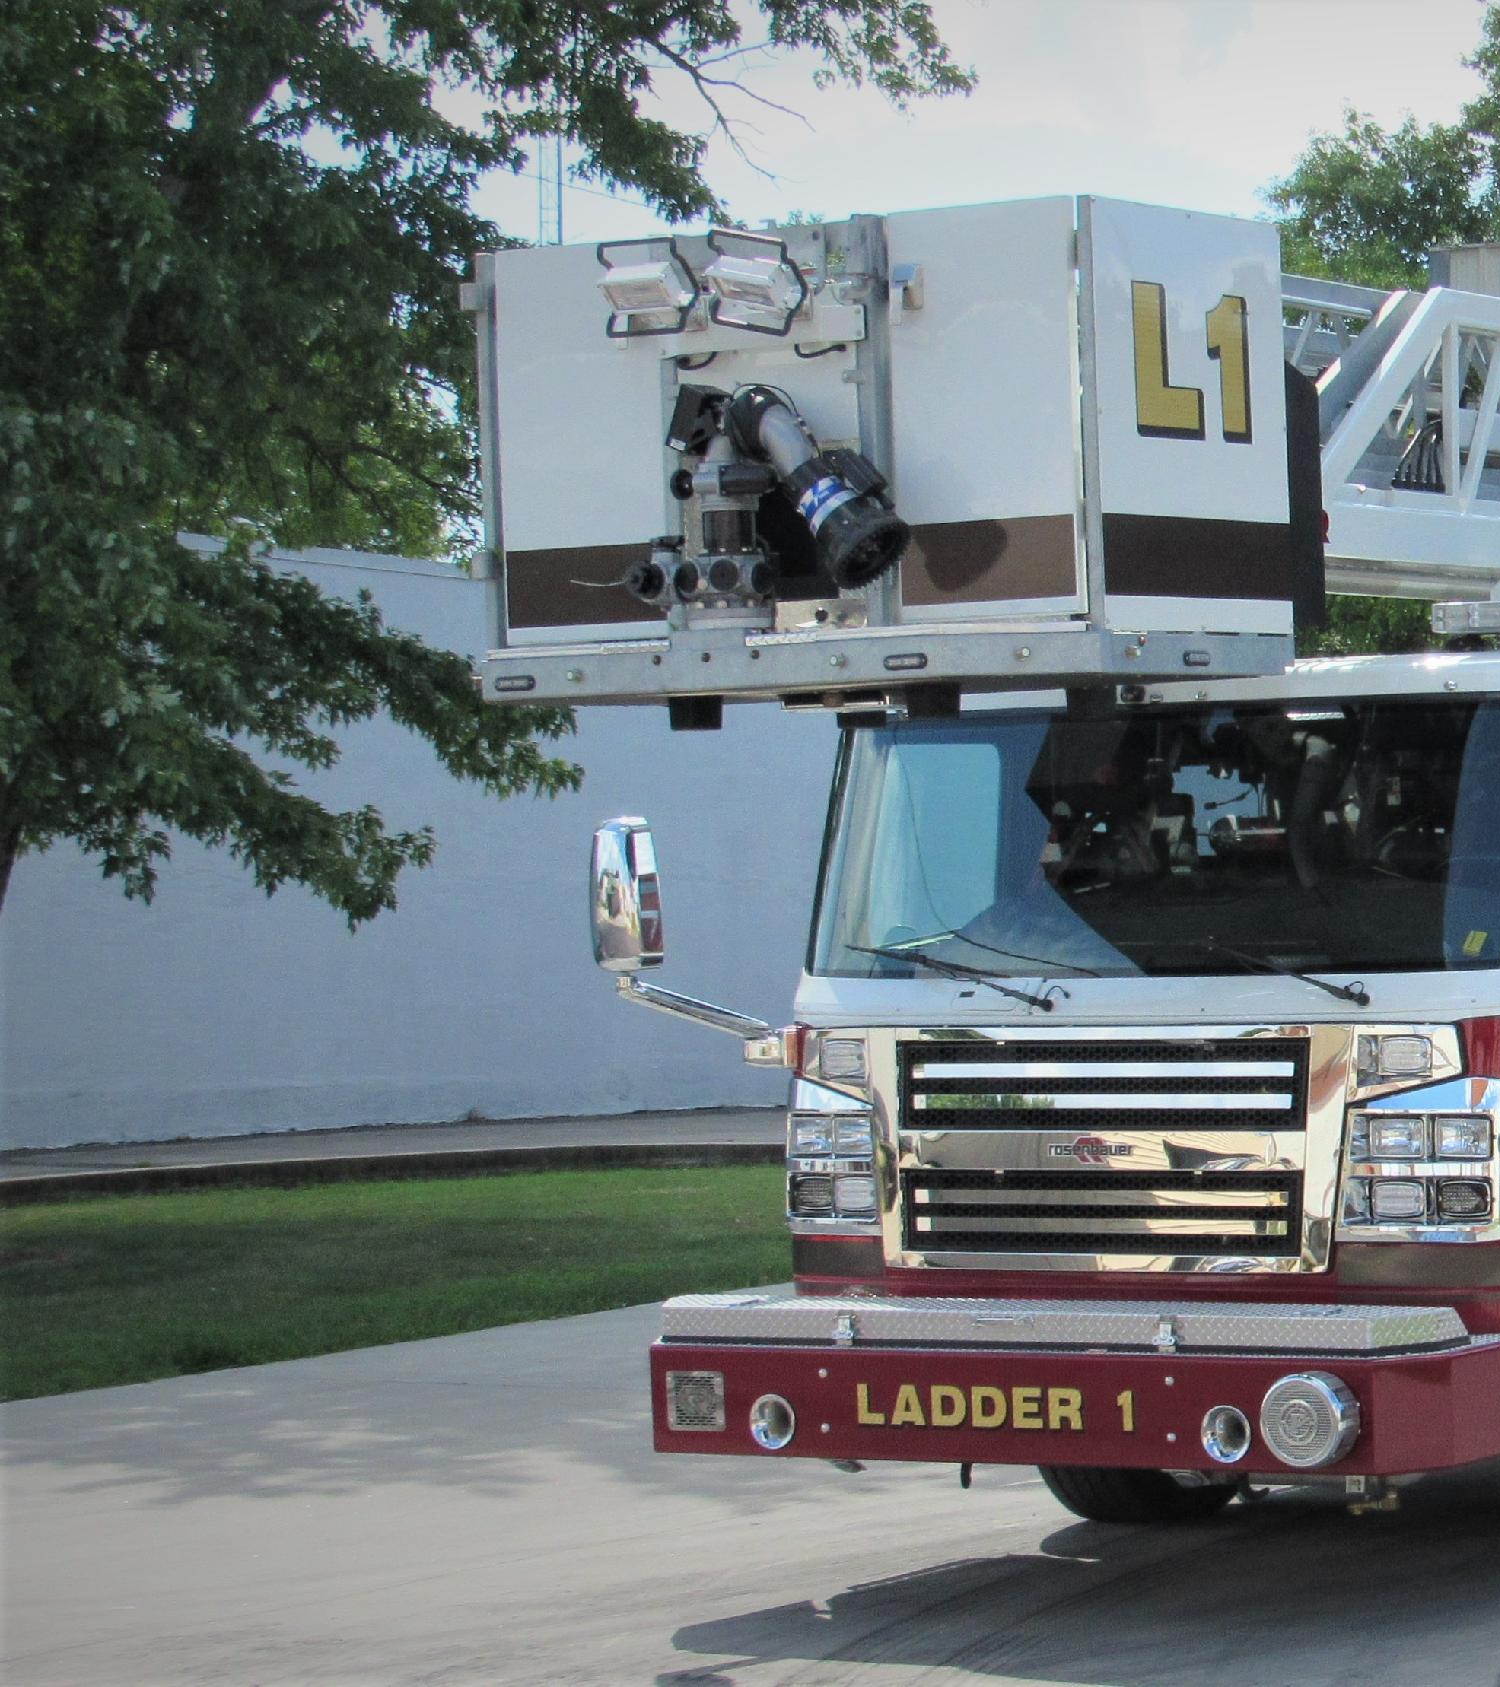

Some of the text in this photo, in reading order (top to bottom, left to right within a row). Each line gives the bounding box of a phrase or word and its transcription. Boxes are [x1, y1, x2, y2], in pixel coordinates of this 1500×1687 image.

[1131, 280, 1252, 444] L1
[1048, 1144, 1133, 1156] rosenbauer
[856, 1383, 1135, 1432] LADDER 1
